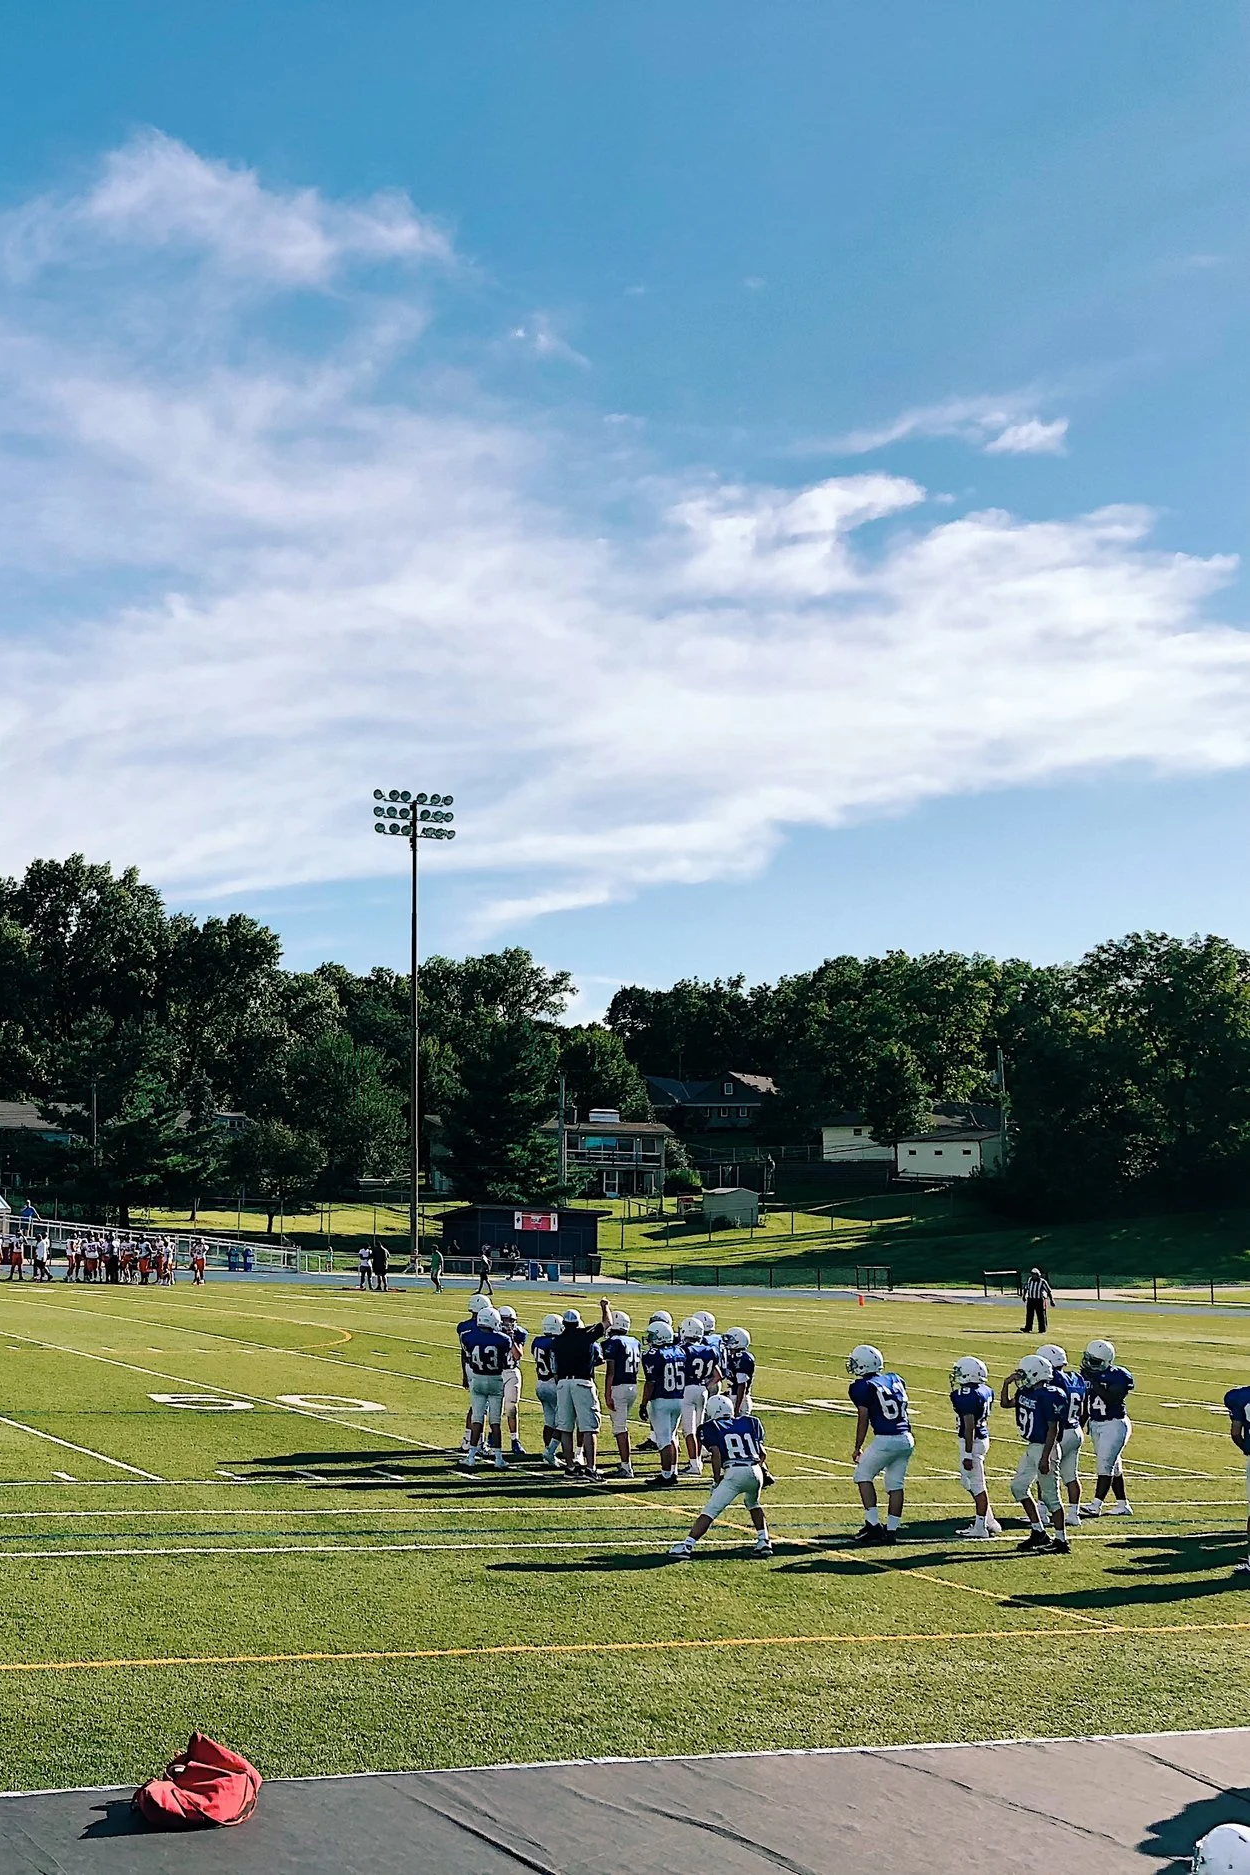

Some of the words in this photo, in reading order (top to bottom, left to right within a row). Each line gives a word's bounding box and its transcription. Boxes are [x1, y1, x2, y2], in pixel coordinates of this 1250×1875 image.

[471, 1345, 499, 1371] 43
[691, 1358, 714, 1379] 31
[663, 1361, 686, 1392] 85
[1017, 1407, 1035, 1439] 91
[723, 1432, 760, 1461] 81
